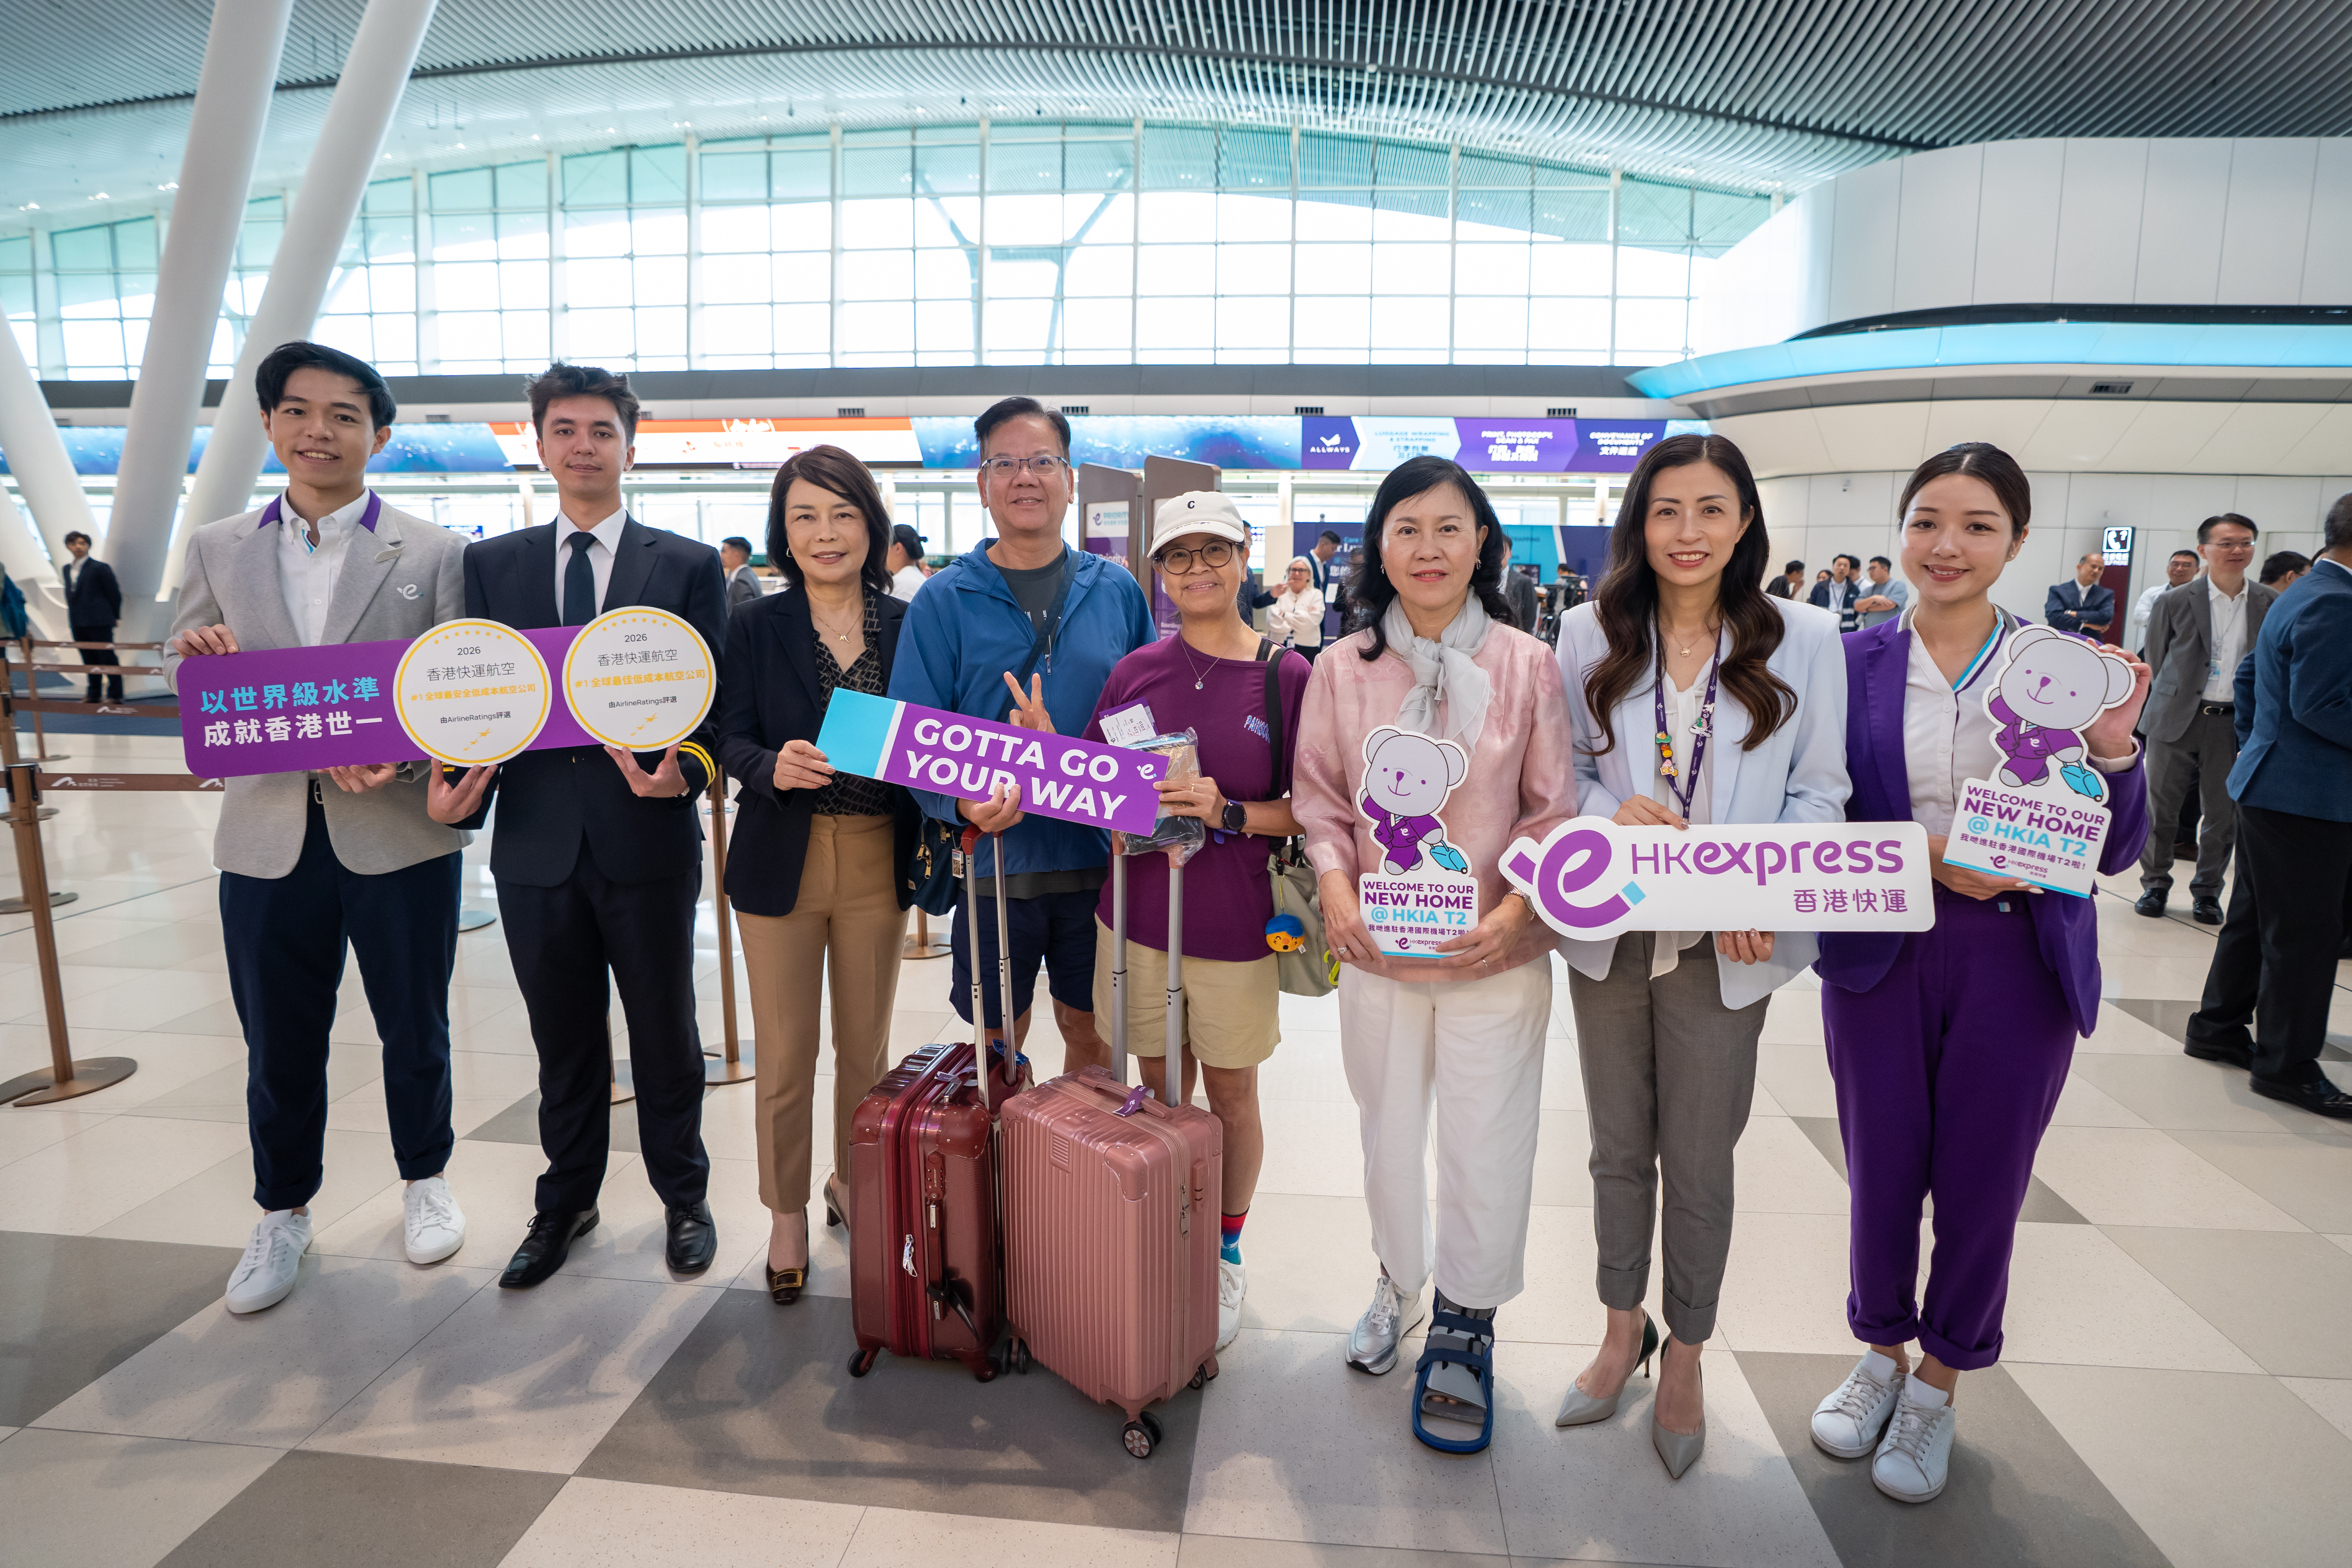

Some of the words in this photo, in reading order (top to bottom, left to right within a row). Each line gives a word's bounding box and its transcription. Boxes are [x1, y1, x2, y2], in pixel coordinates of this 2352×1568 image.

[1187, 500, 1195, 509] C
[625, 634, 647, 642] 2026
[457, 646, 481, 656] 2026
[597, 649, 678, 667] 香港快運航空
[426, 662, 515, 681] 香港快運航空
[201, 677, 380, 714] 以世界級水準
[608, 696, 677, 708] 由AirlineRatings評選
[440, 711, 511, 724] 由AirlineRatings評選
[204, 711, 383, 748] 成就香港世一
[914, 719, 1045, 771] GOTTA
[1060, 749, 1119, 782] GO
[906, 750, 1017, 798] YOUR
[1031, 777, 1127, 820] WAY
[1967, 785, 2043, 811] WELCOME
[2047, 804, 2067, 816] TO
[2071, 810, 2105, 825] OUR
[1963, 797, 2022, 822] NEW
[2027, 812, 2101, 842] HOME
[1967, 816, 1989, 835] @
[1994, 822, 2051, 849] HKIA
[2059, 837, 2087, 857] T2
[1632, 841, 1904, 886] HKexpress
[1363, 881, 1424, 892] WELCOME
[1427, 884, 1444, 893] TO
[1447, 885, 1474, 894] OUR
[1365, 892, 1409, 907] NEW
[1416, 894, 1473, 909] HOME
[1793, 889, 1907, 913] 香港快運
[1371, 907, 1388, 923] @
[1393, 909, 1438, 923] HKIA
[1444, 911, 1467, 925] T2
